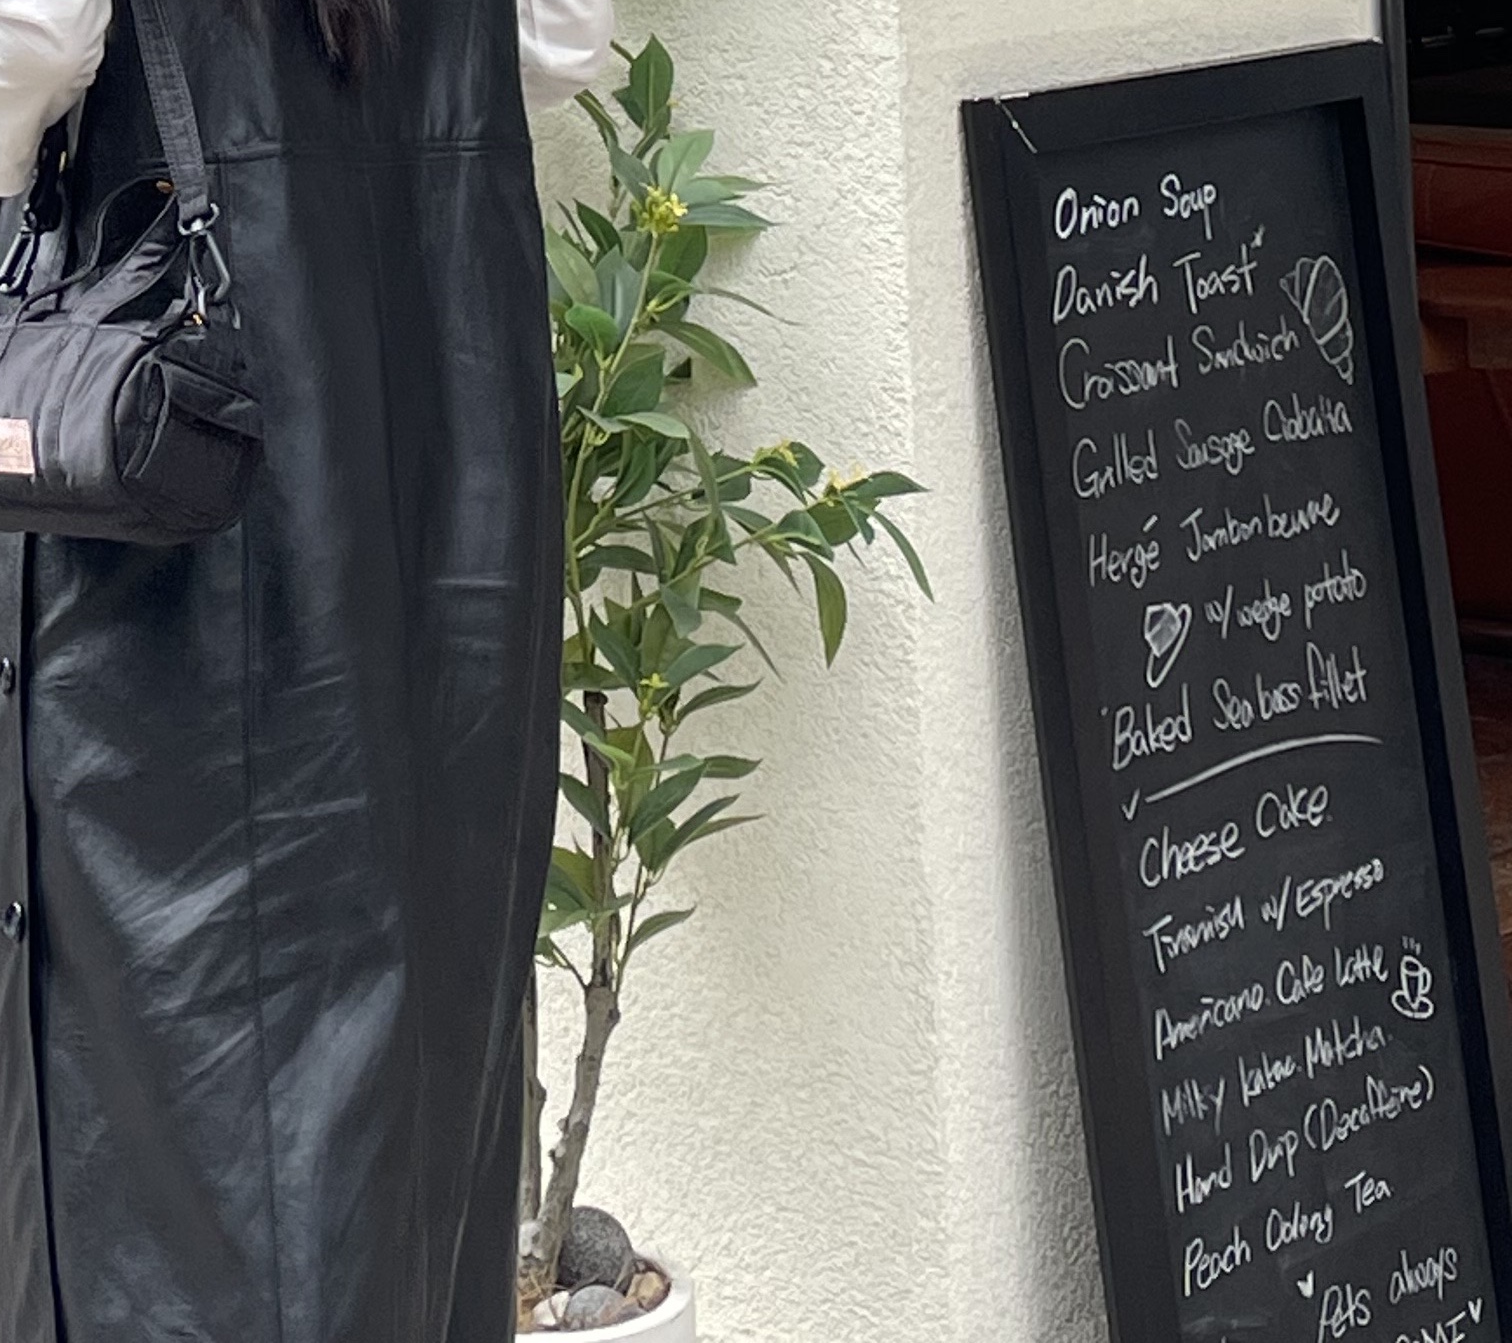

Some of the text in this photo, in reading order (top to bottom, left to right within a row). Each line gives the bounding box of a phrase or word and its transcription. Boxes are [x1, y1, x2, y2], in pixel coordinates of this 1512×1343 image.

[1055, 173, 1217, 241] Onion Soup
[1053, 242, 1258, 325] Danish Toast
[1072, 428, 1159, 499] Grilled
[1174, 418, 1256, 475] Sausage
[1089, 514, 1160, 589] Hergé
[1303, 548, 1367, 631] potato
[1112, 682, 1192, 771] Baked
[1139, 825, 1245, 888] Cheese
[1294, 857, 1385, 932] Espresso
[1161, 1077, 1226, 1137] Milky
[1175, 1141, 1232, 1214] Hand
[1249, 1128, 1300, 1184] Drip
[1183, 1224, 1252, 1298] Peach
[1389, 1247, 1459, 1306] always
